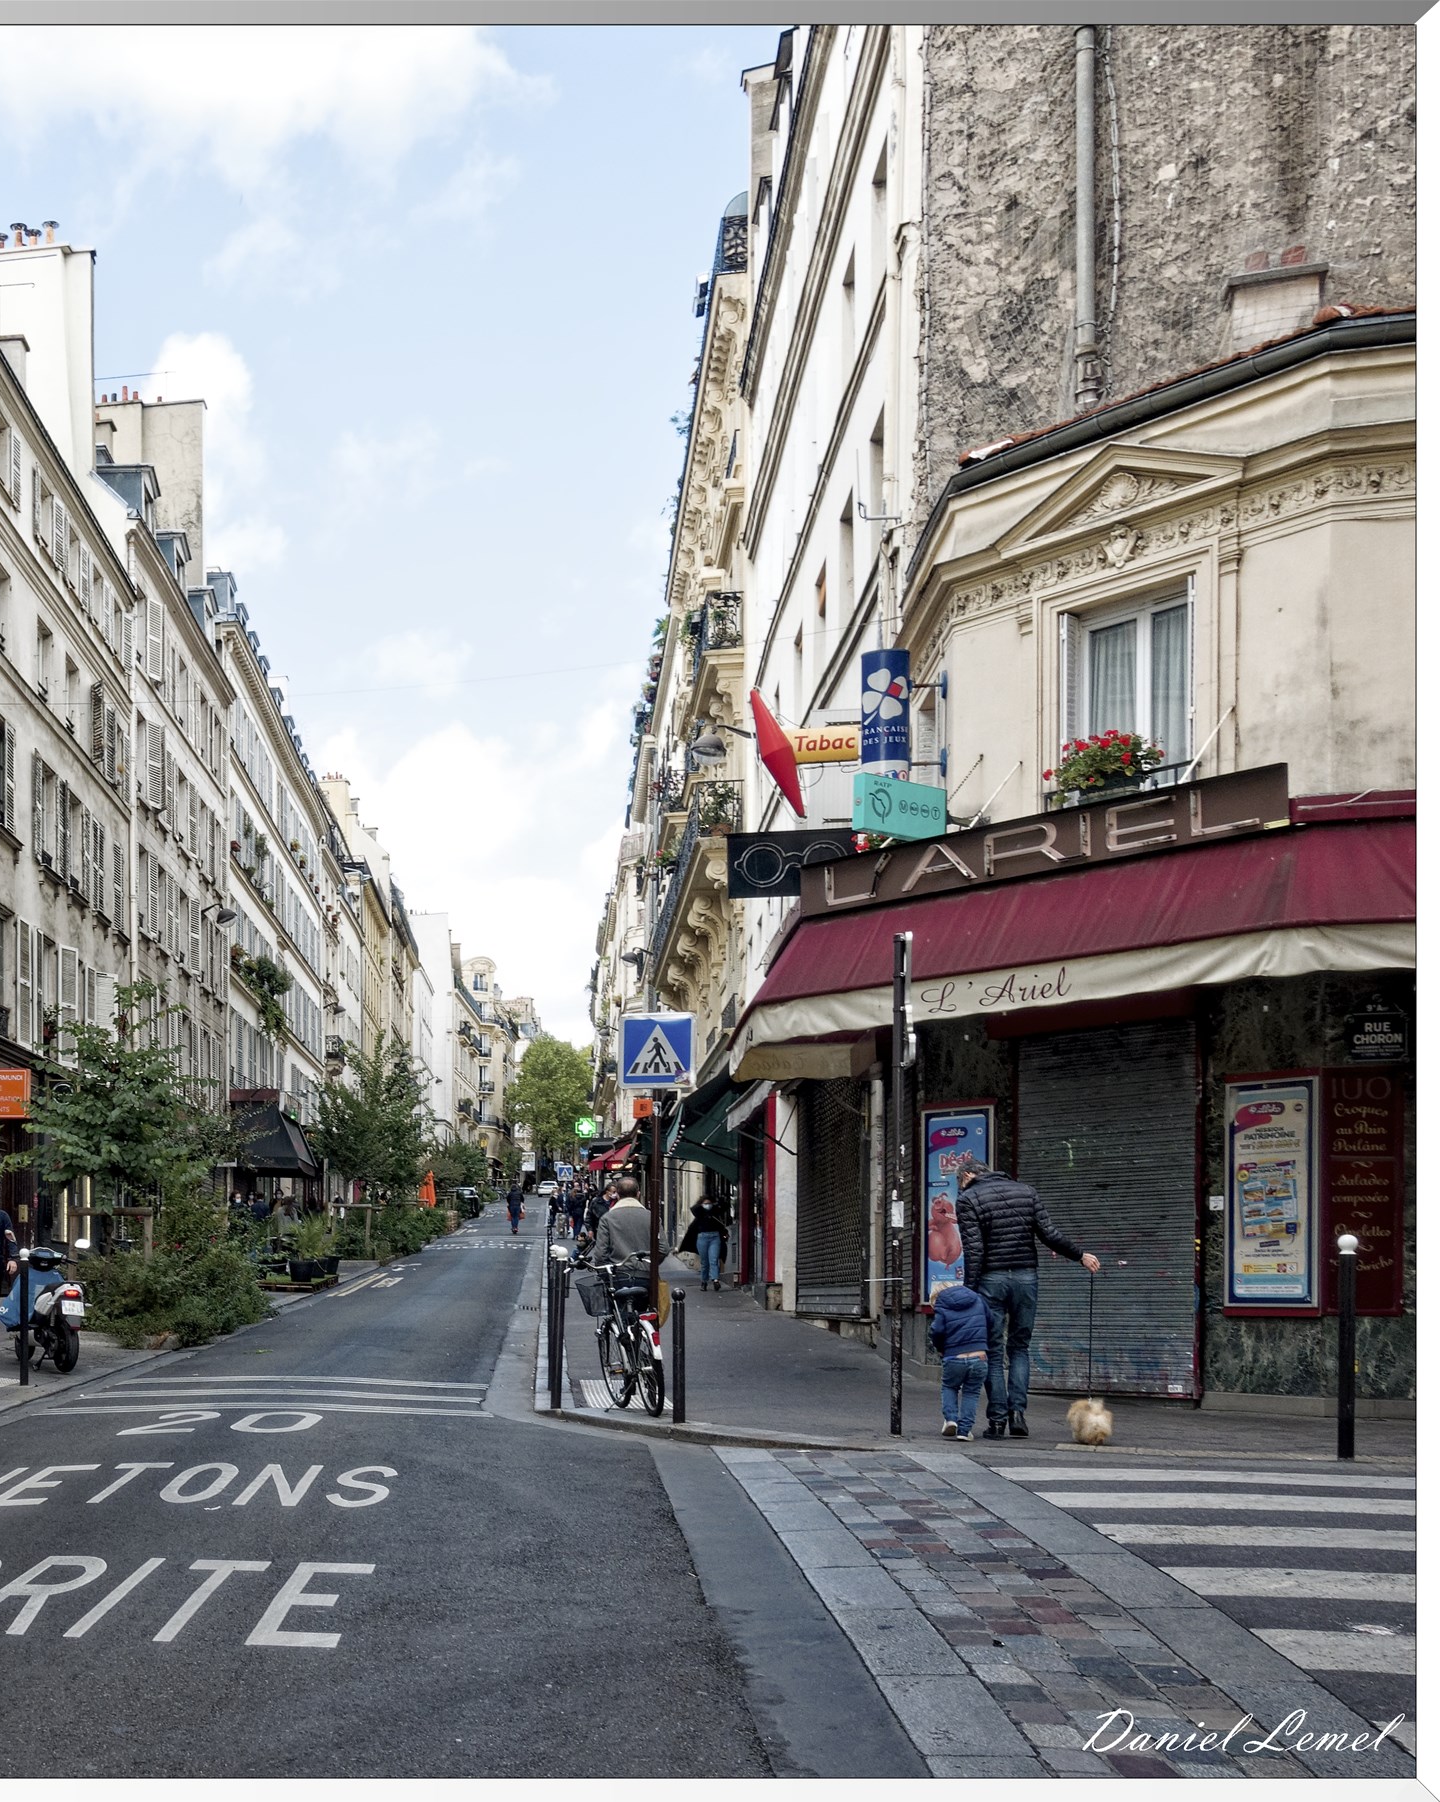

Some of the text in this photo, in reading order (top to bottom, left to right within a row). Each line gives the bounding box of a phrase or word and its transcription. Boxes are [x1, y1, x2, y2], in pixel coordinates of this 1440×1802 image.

[794, 734, 856, 752] Tabac
[863, 735, 907, 746] DES JEUX
[873, 780, 893, 788] RATP
[823, 789, 1261, 906] L'ARIEL
[1364, 1021, 1392, 1033] RUE
[1353, 1033, 1403, 1045] CHORON
[1333, 1102, 1389, 1118] Croques
[1336, 1120, 1388, 1135] au Pain
[1243, 1131, 1296, 1140] PATRIMOINE
[117, 1409, 324, 1437] 20
